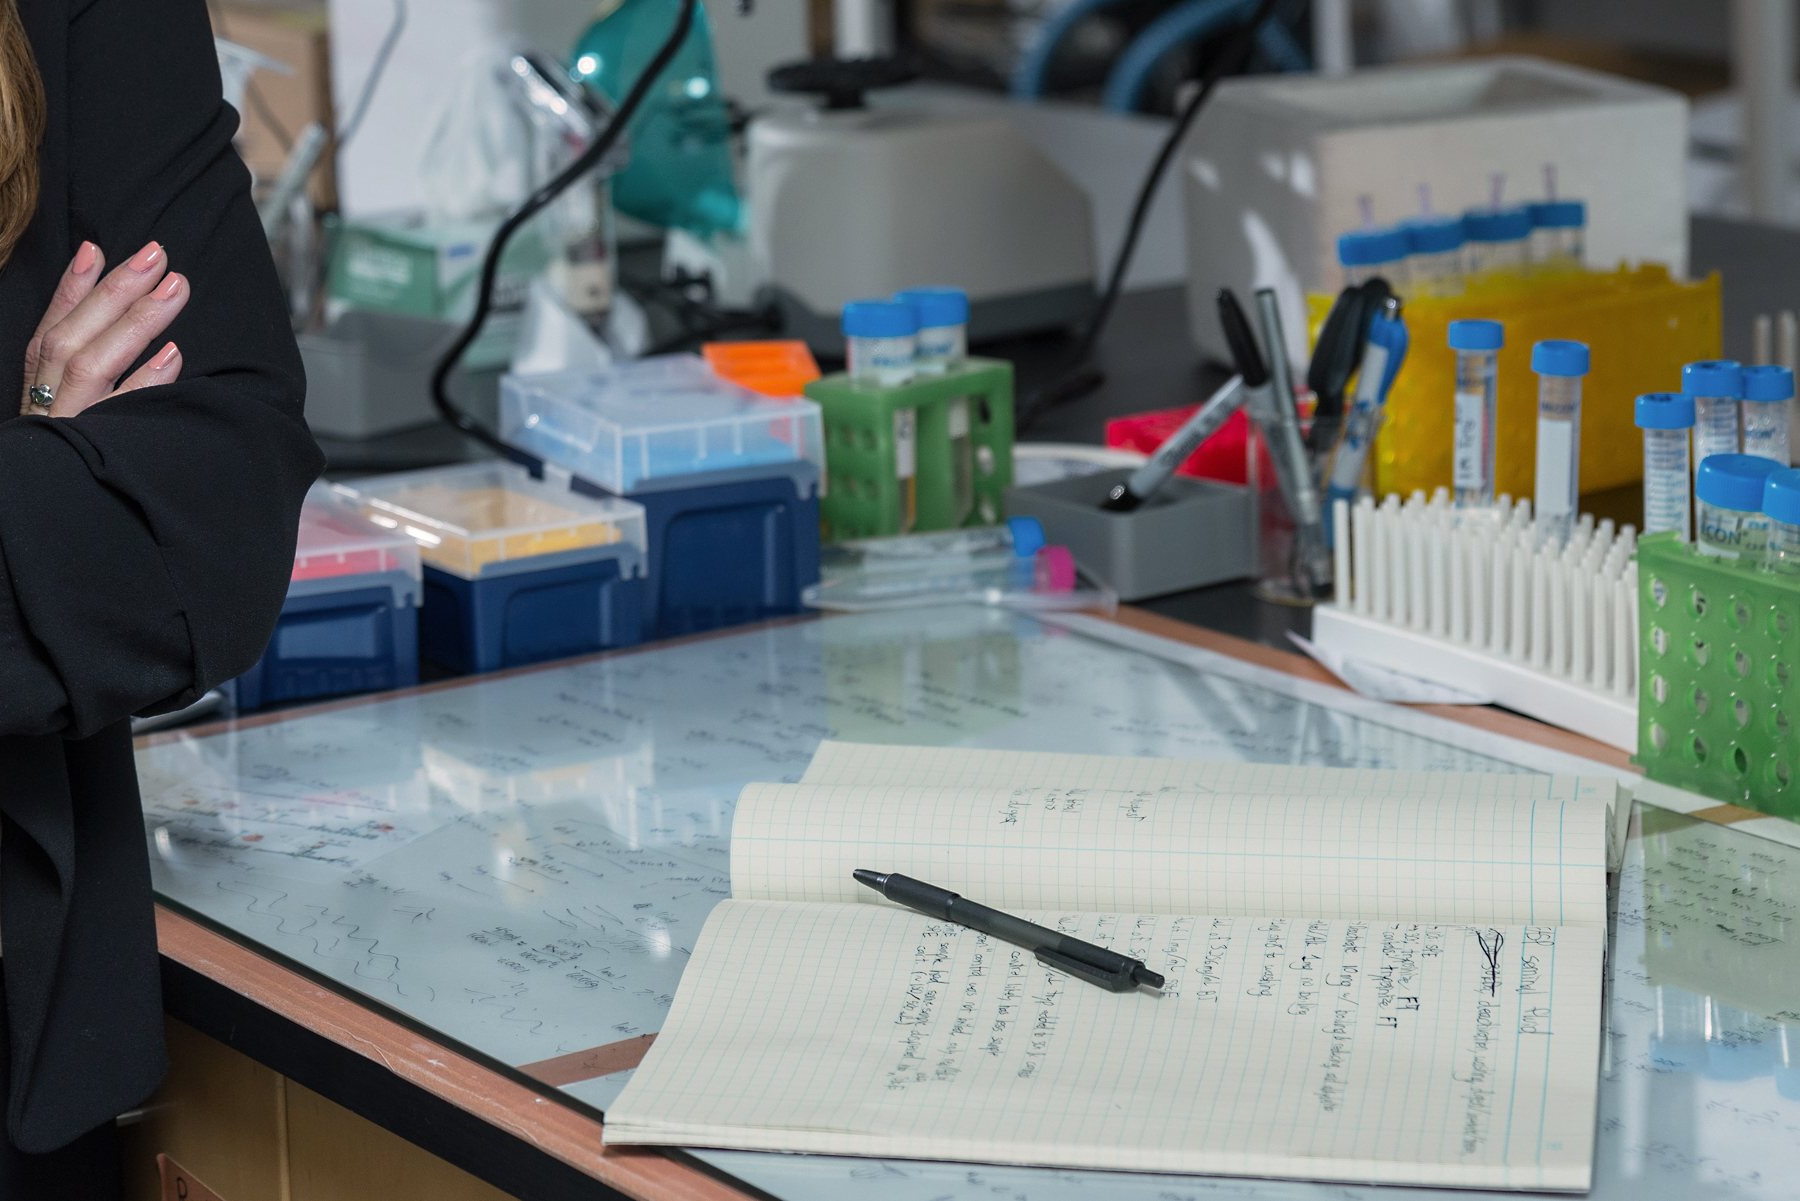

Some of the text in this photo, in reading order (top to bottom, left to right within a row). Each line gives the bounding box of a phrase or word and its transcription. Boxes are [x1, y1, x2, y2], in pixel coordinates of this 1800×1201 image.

[926, 969, 949, 984] had
[1246, 964, 1279, 996] washing
[1515, 955, 1544, 994] seminal
[1518, 1006, 1553, 1034] fluid
